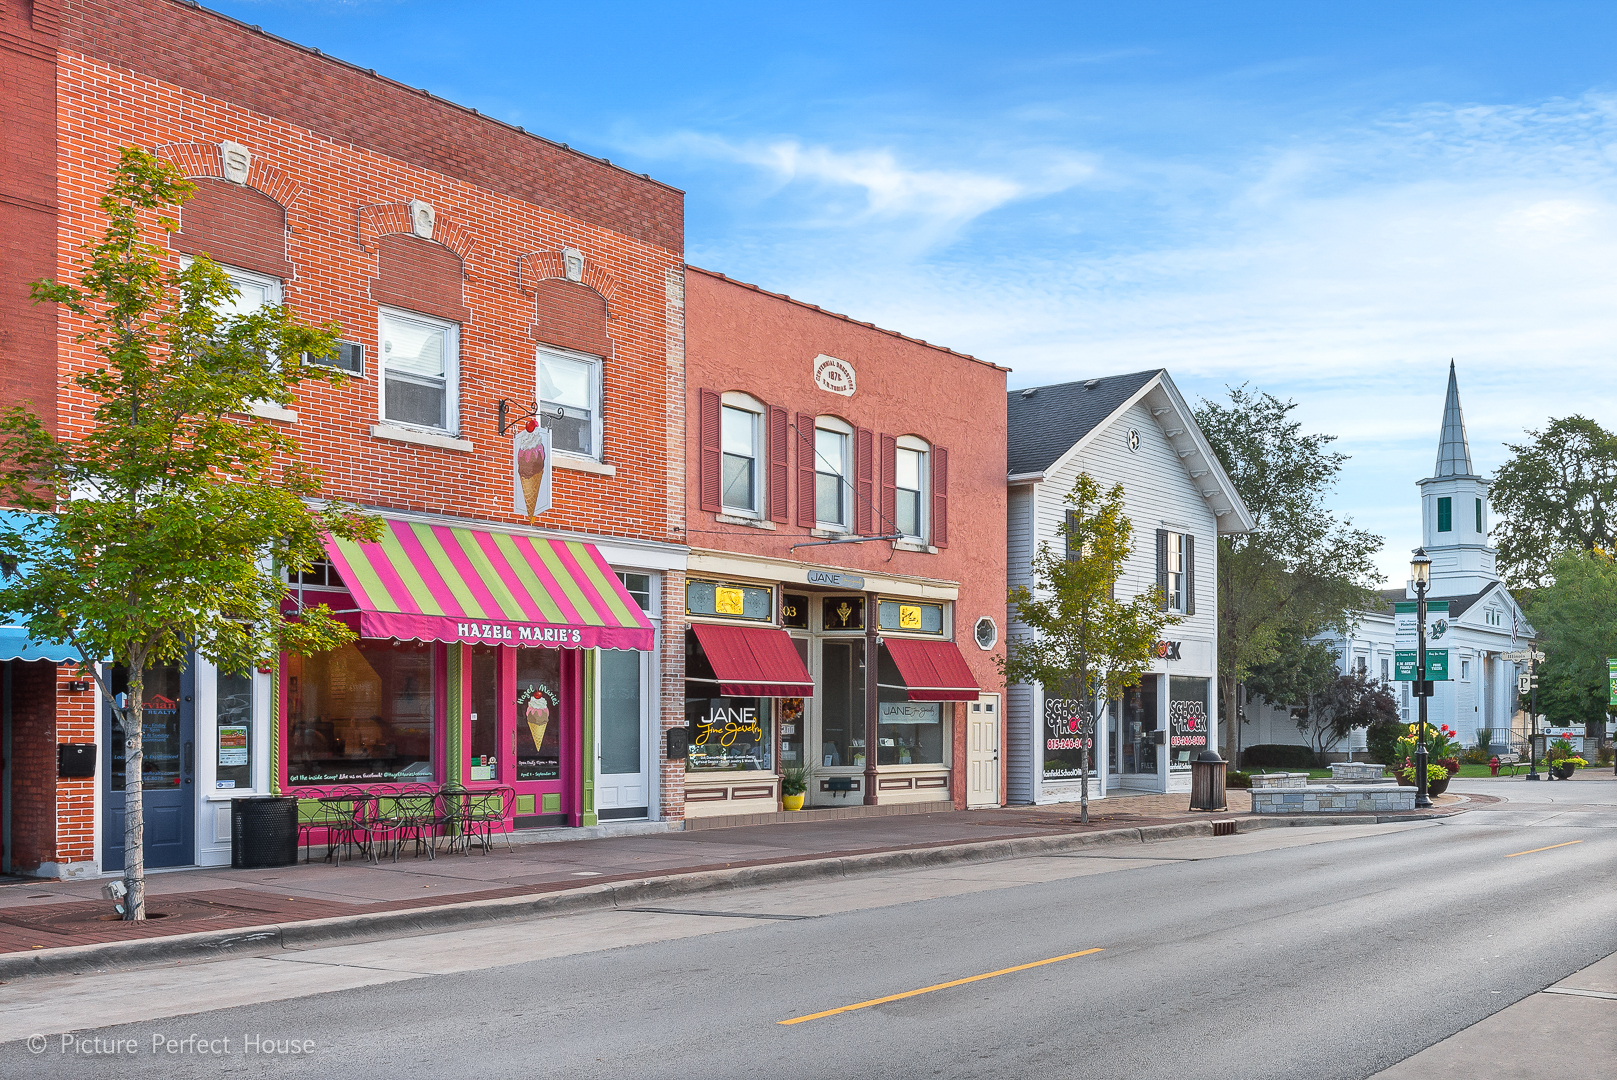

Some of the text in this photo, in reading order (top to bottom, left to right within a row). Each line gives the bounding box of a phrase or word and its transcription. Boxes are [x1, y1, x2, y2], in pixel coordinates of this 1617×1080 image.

[811, 573, 840, 585] JANE
[457, 622, 581, 643] HAZEL MARIE'S
[1519, 677, 1528, 689] P
[517, 684, 560, 707] Hazel Marie's
[701, 707, 756, 723] JANE
[884, 706, 910, 716] JANE
[1170, 700, 1204, 717] SCHOOL
[1180, 713, 1207, 733] ROCK
[696, 717, 763, 747] Fine Jewelry
